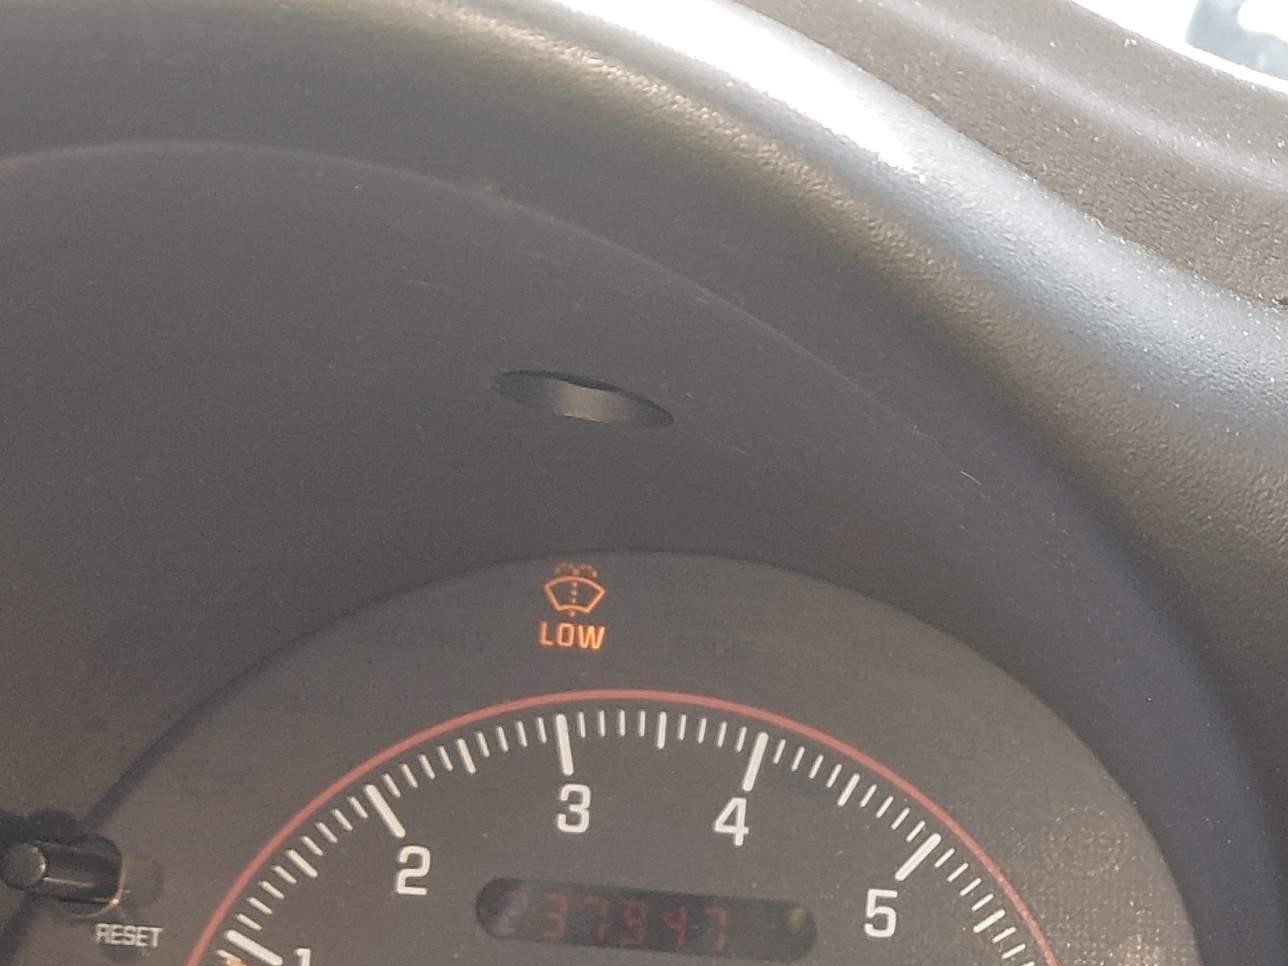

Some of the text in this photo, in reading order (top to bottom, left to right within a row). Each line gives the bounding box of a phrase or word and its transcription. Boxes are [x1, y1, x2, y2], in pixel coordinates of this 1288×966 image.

[539, 622, 605, 650] LOW
[558, 784, 590, 832] 3
[715, 798, 748, 846] 4
[397, 846, 430, 895] 2
[95, 922, 163, 948] RESET
[865, 889, 897, 937] 5
